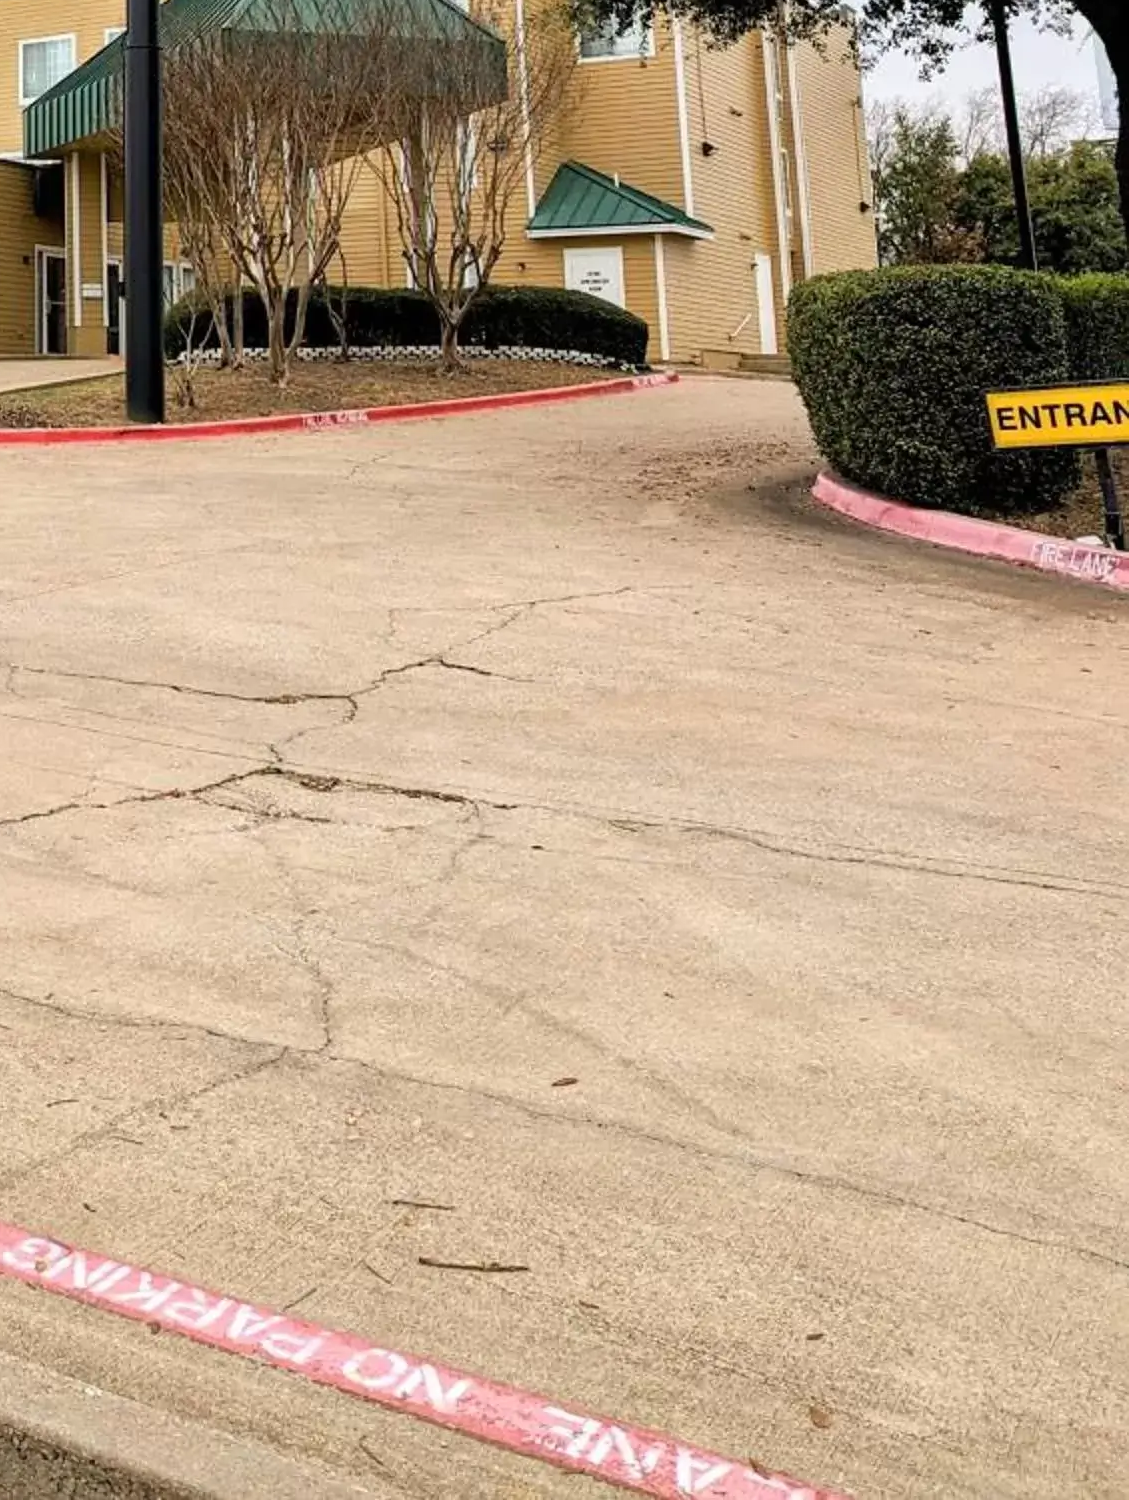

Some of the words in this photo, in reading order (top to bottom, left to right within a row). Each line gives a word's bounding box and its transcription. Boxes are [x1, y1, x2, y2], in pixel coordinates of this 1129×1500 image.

[995, 400, 1129, 431] ENTRAN
[2, 1235, 328, 1365] PARKING
[342, 1347, 472, 1412] NO
